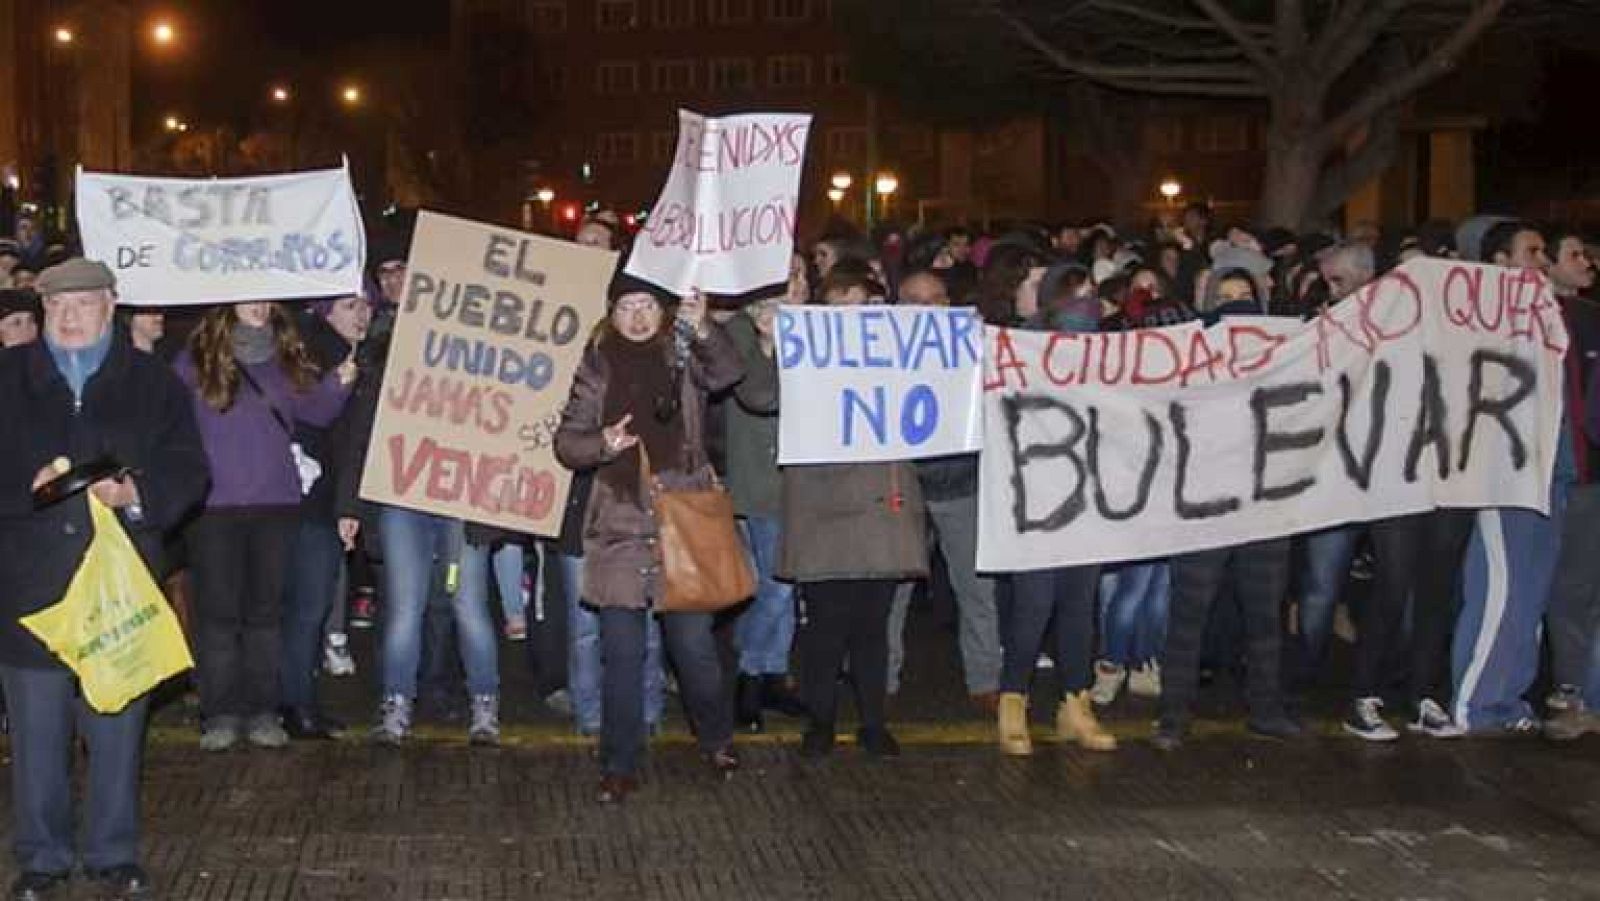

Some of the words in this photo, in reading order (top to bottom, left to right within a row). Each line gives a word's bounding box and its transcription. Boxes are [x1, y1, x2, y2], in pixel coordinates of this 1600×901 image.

[103, 184, 272, 227] BASTA
[117, 247, 154, 269] DE
[483, 234, 547, 287] EL
[403, 273, 579, 346] PUEBLO
[778, 310, 979, 370] BULEVAR
[1043, 325, 1287, 388] CIUDAD
[1316, 270, 1422, 374] NO
[423, 329, 554, 392] UNIDO
[840, 383, 939, 446] NO
[1004, 350, 1538, 533] BULEVAR
[388, 433, 557, 521] VENCIDO
